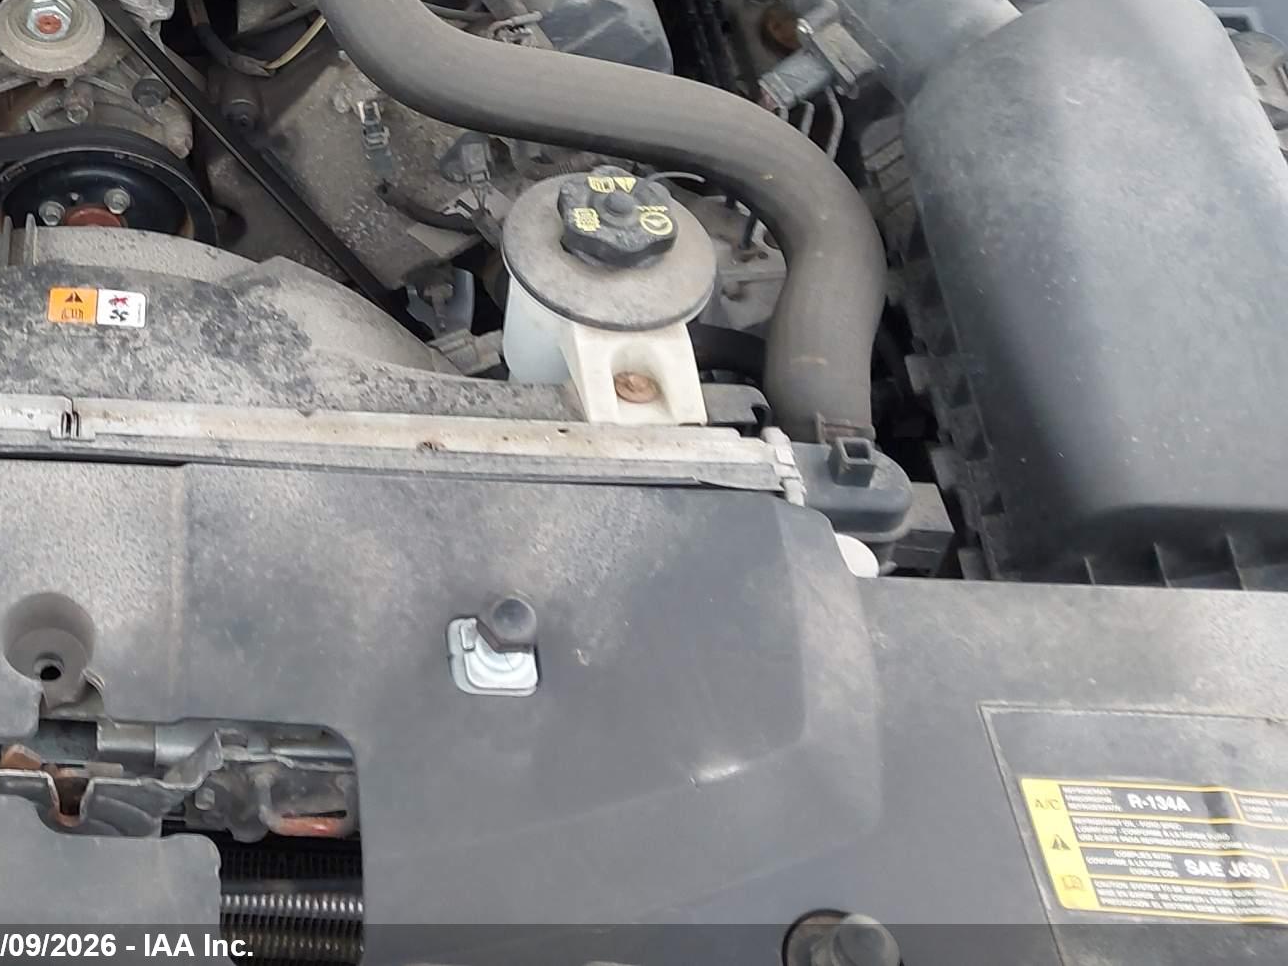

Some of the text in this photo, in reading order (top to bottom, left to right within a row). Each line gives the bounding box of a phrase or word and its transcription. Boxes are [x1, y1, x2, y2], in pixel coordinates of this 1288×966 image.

[1127, 792, 1192, 812] R-134A
[1183, 858, 1271, 880] SAE J639
